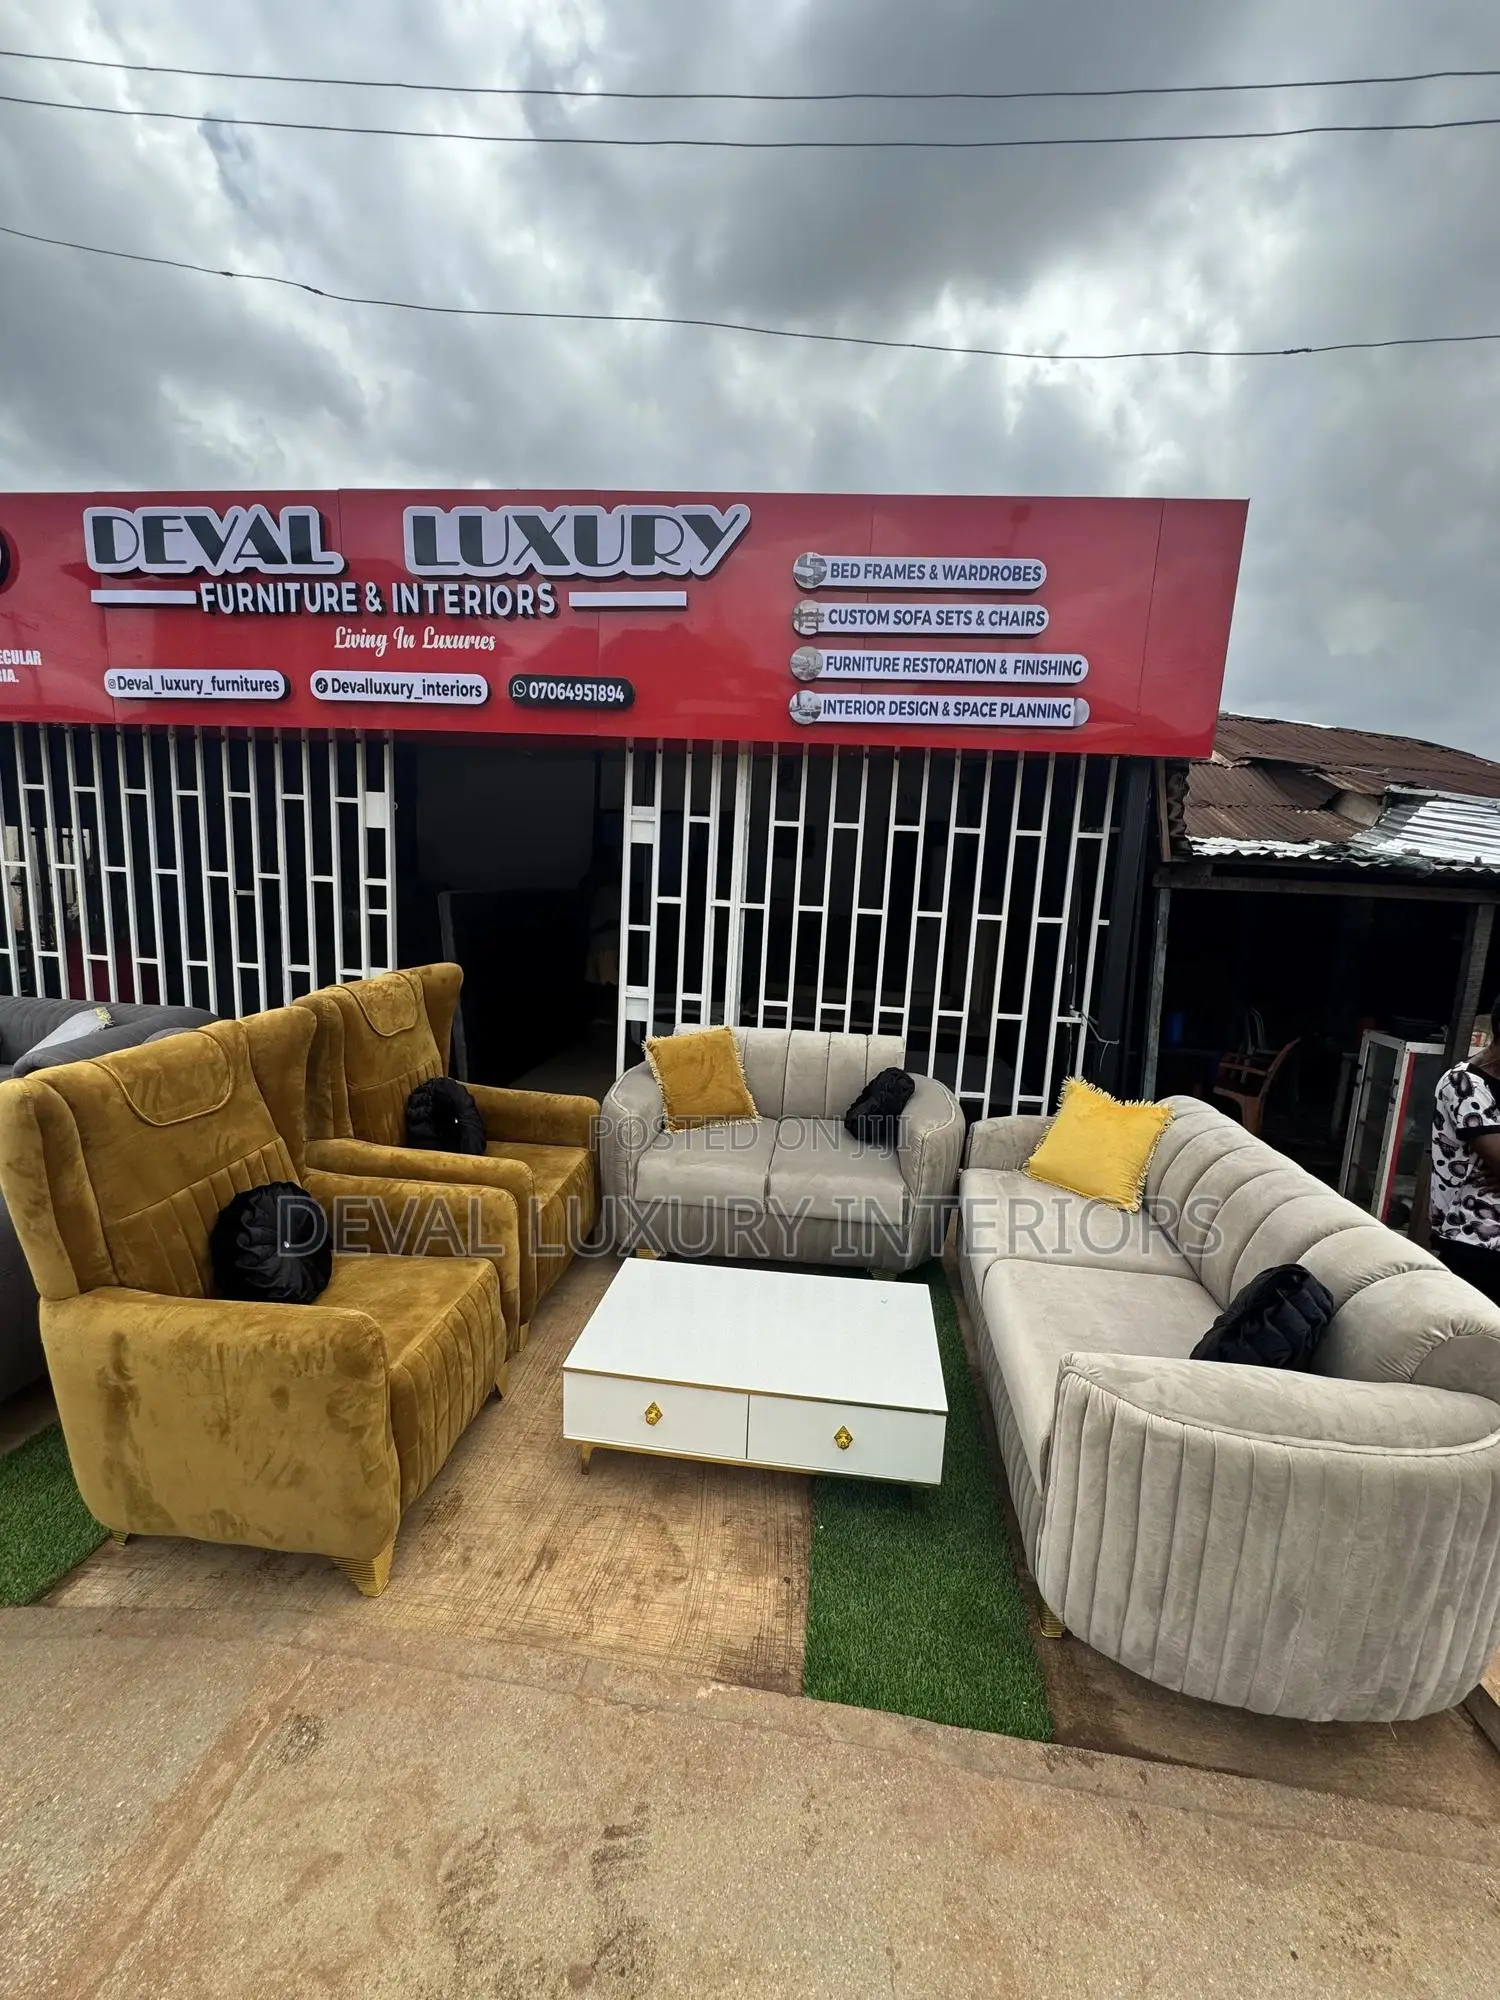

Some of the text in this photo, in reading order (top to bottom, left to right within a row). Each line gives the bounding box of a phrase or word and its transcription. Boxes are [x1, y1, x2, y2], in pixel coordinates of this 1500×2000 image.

[88, 509, 746, 572] DEVAL LUXURY
[830, 563, 1042, 582] BED FRAMES & WARDROBES
[200, 581, 557, 616] FURNITURE & INTERIORS
[828, 608, 1046, 627] CUSTOM SOFA SETS & CHAIRS
[334, 626, 497, 657] Living In Luxuries
[826, 655, 1083, 677] FURNITURE RESTORATION & FINISHING
[117, 675, 280, 695] Deval_luxury_furnitures
[331, 677, 482, 699] Devalluxury_interiors
[529, 682, 625, 703] 07064951894
[823, 699, 1072, 719] INTERIOR DESIGN & SPACE PLANNING
